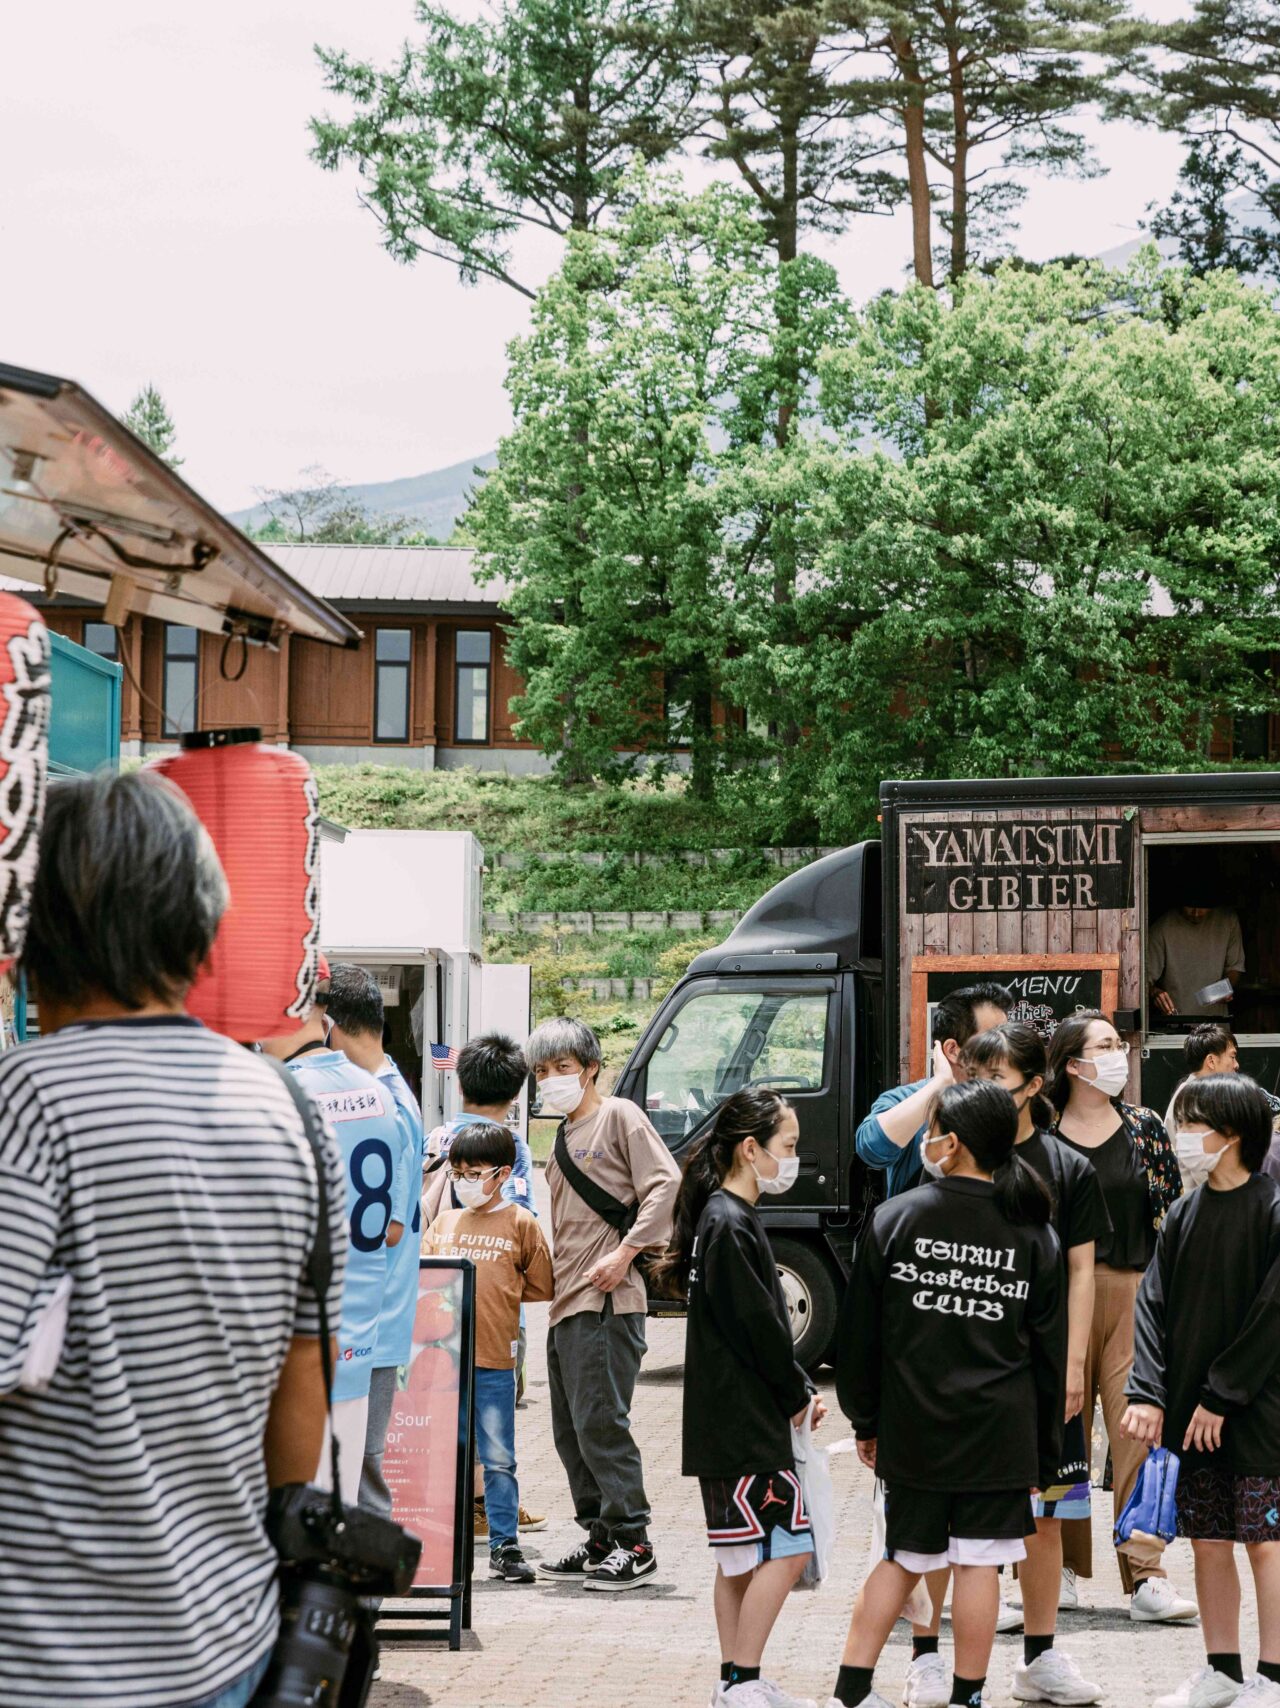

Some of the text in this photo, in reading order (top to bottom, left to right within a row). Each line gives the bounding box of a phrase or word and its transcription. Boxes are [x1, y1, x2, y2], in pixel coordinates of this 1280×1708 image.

[914, 824, 1122, 866] YAMATSUMI
[950, 874, 1098, 910] GIBIER
[1006, 976, 1081, 996] MENU
[350, 1138, 393, 1251] 8
[434, 1233, 513, 1251] THE FUTURE
[450, 1246, 501, 1262] BRIGHT
[890, 1261, 1029, 1300] Basketball
[912, 1290, 1004, 1320] CLUB
[394, 1412, 431, 1427] Sour
